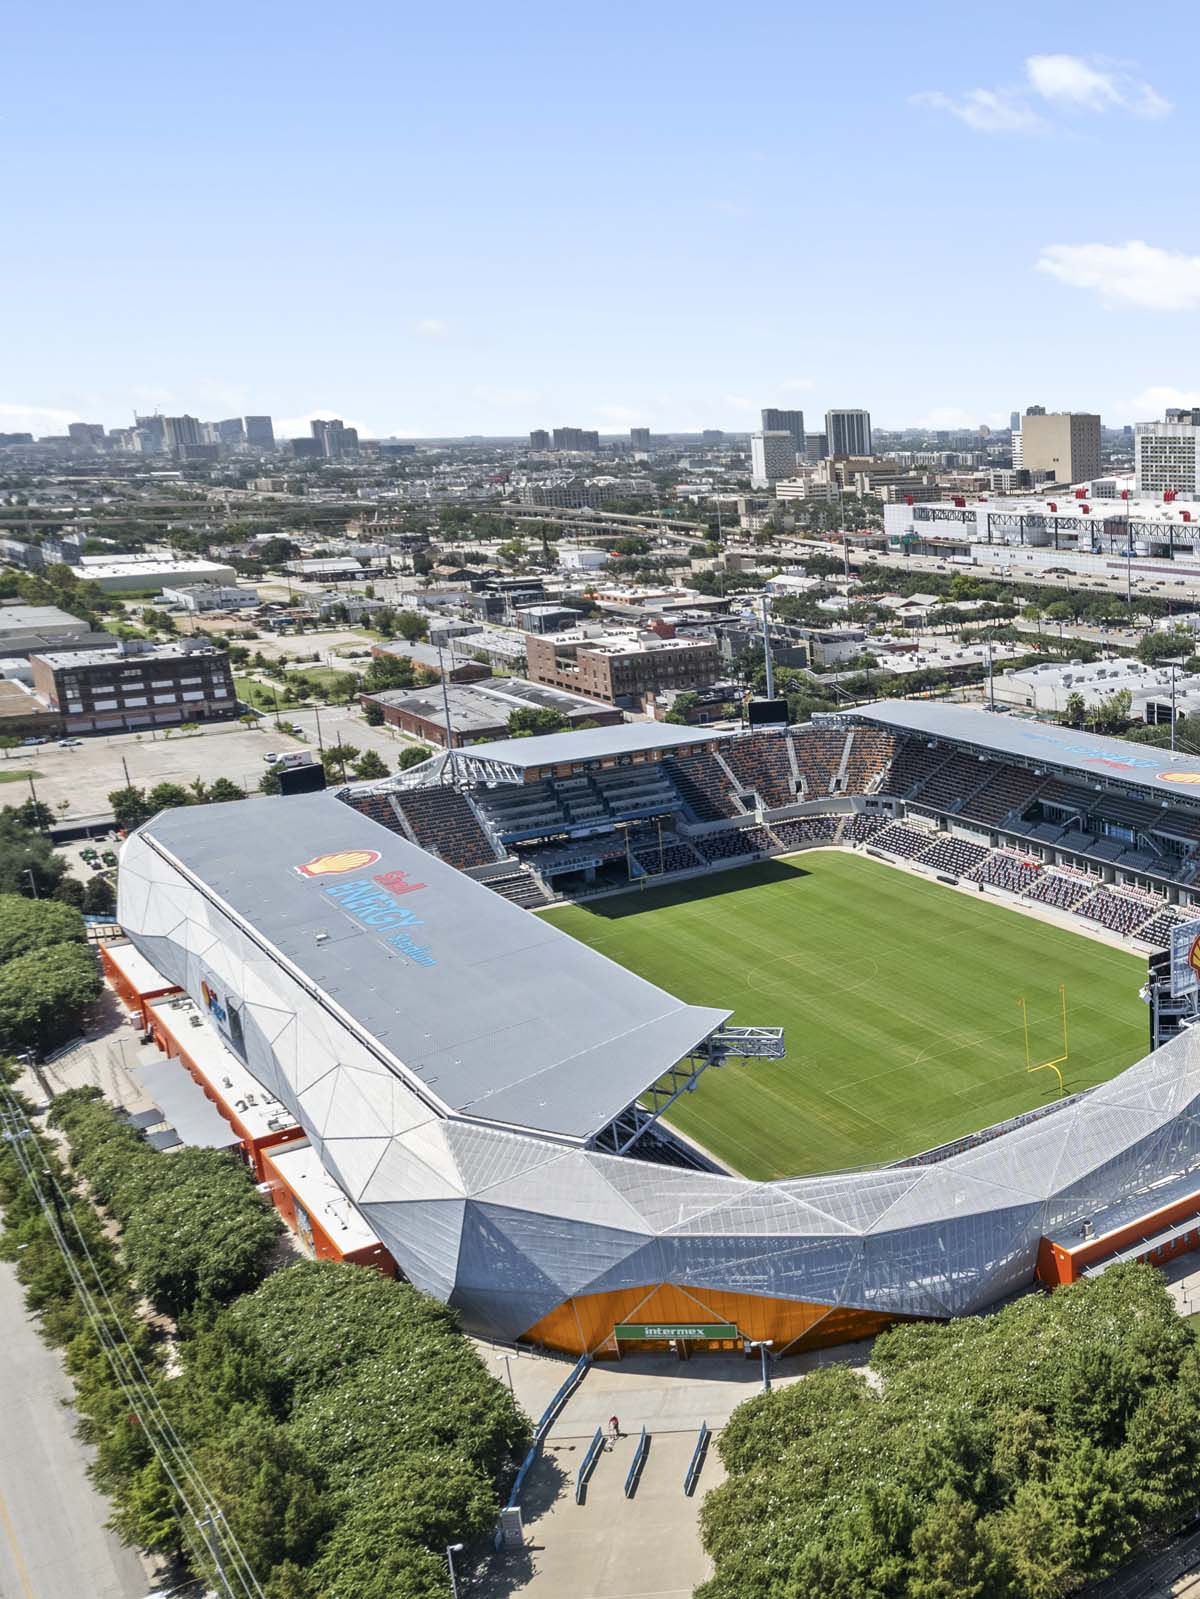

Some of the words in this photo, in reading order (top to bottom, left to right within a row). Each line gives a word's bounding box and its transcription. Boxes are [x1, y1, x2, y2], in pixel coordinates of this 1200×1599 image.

[372, 870, 428, 896] Shell
[320, 879, 425, 933] ENERGY
[645, 1327, 704, 1336] intermex
